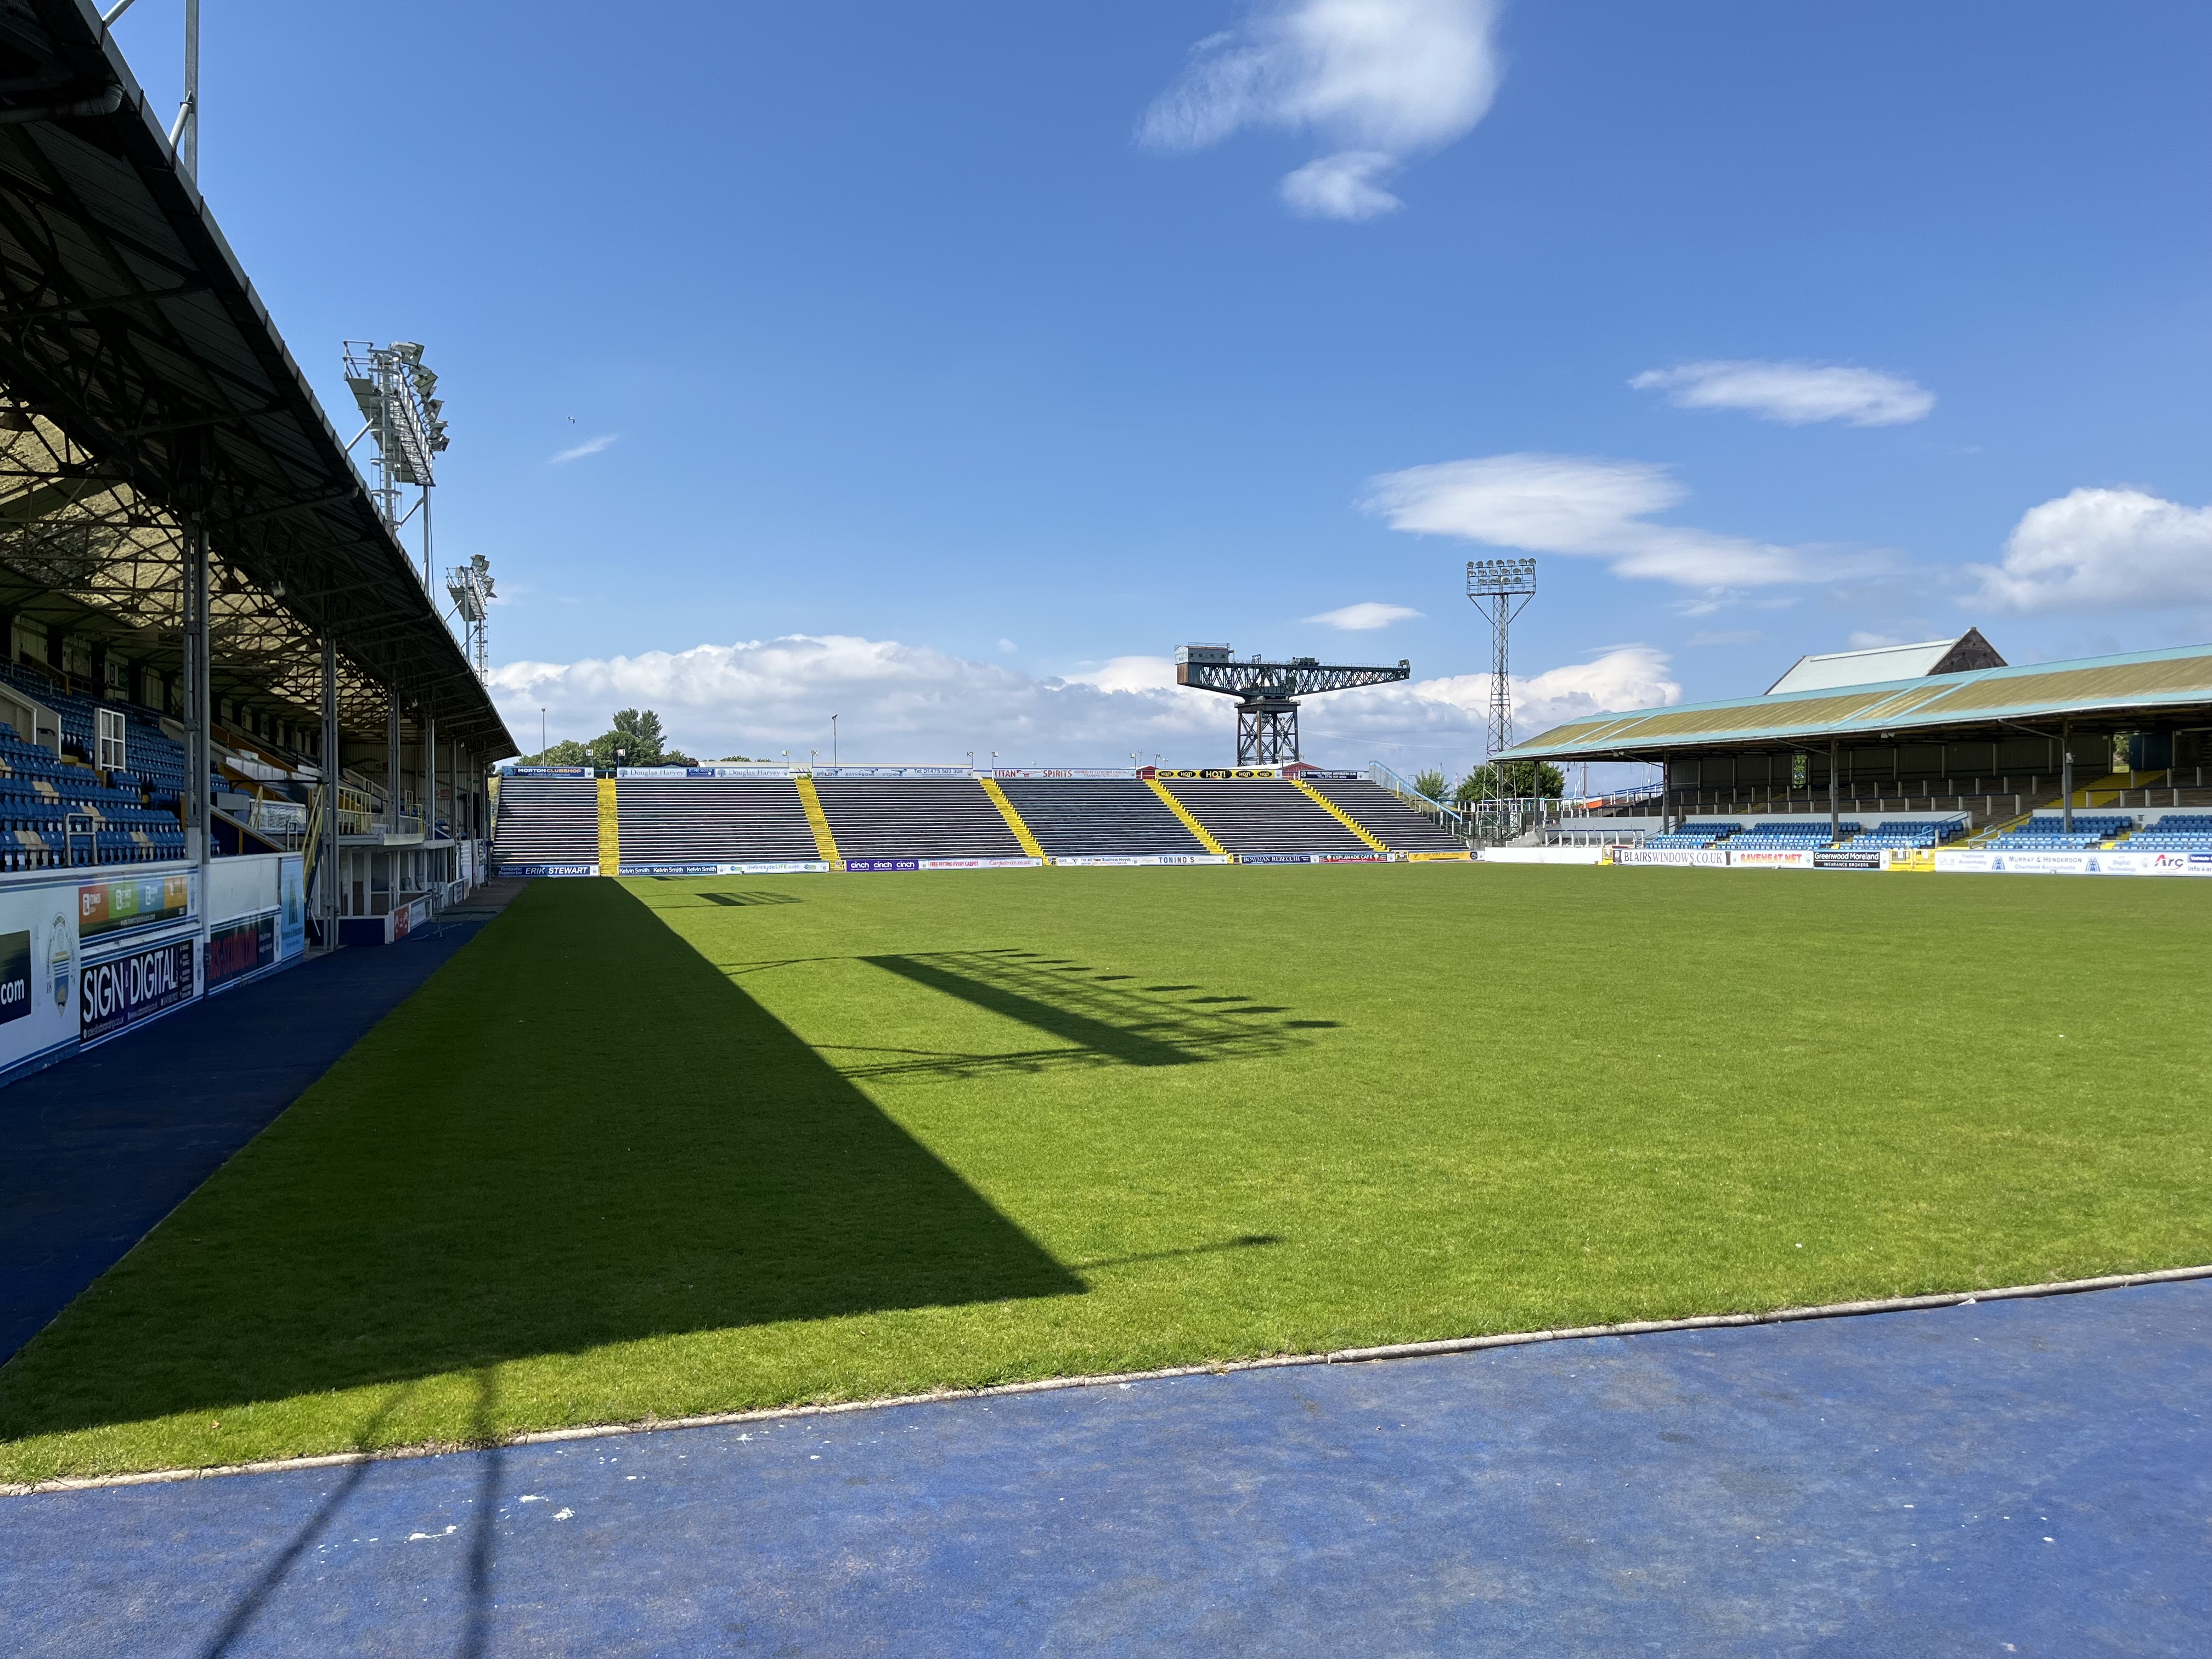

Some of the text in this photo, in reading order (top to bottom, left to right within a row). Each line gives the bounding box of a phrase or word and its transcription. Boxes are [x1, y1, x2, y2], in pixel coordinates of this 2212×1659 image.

[1624, 851, 1723, 864] BLAIRSWINDOWS.CO.UK
[1740, 854, 1802, 864] SAVEHEAT.NET
[2154, 854, 2185, 867] Arc
[83, 962, 125, 1023] SIGN
[130, 947, 177, 1005] DIGITAL
